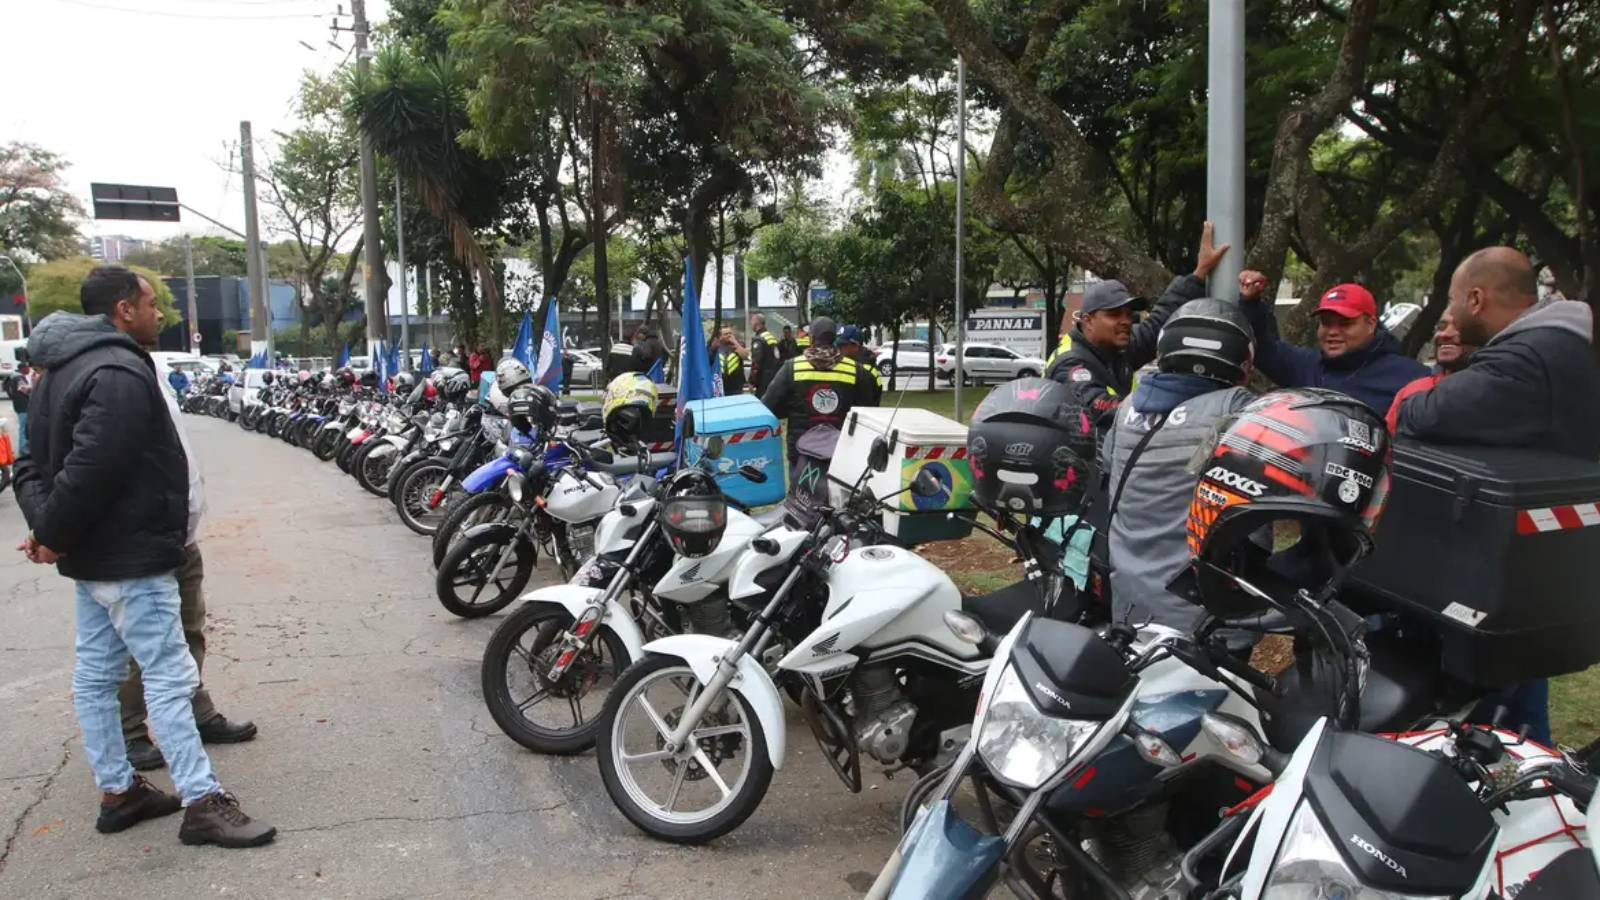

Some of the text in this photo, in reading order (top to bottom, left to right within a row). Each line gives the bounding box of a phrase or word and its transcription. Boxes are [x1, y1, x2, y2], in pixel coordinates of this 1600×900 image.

[975, 318, 1034, 330] PANNAN
[1205, 466, 1268, 497] AXXIS
[1036, 682, 1071, 710] HONDA
[1350, 833, 1408, 879] HONDA
